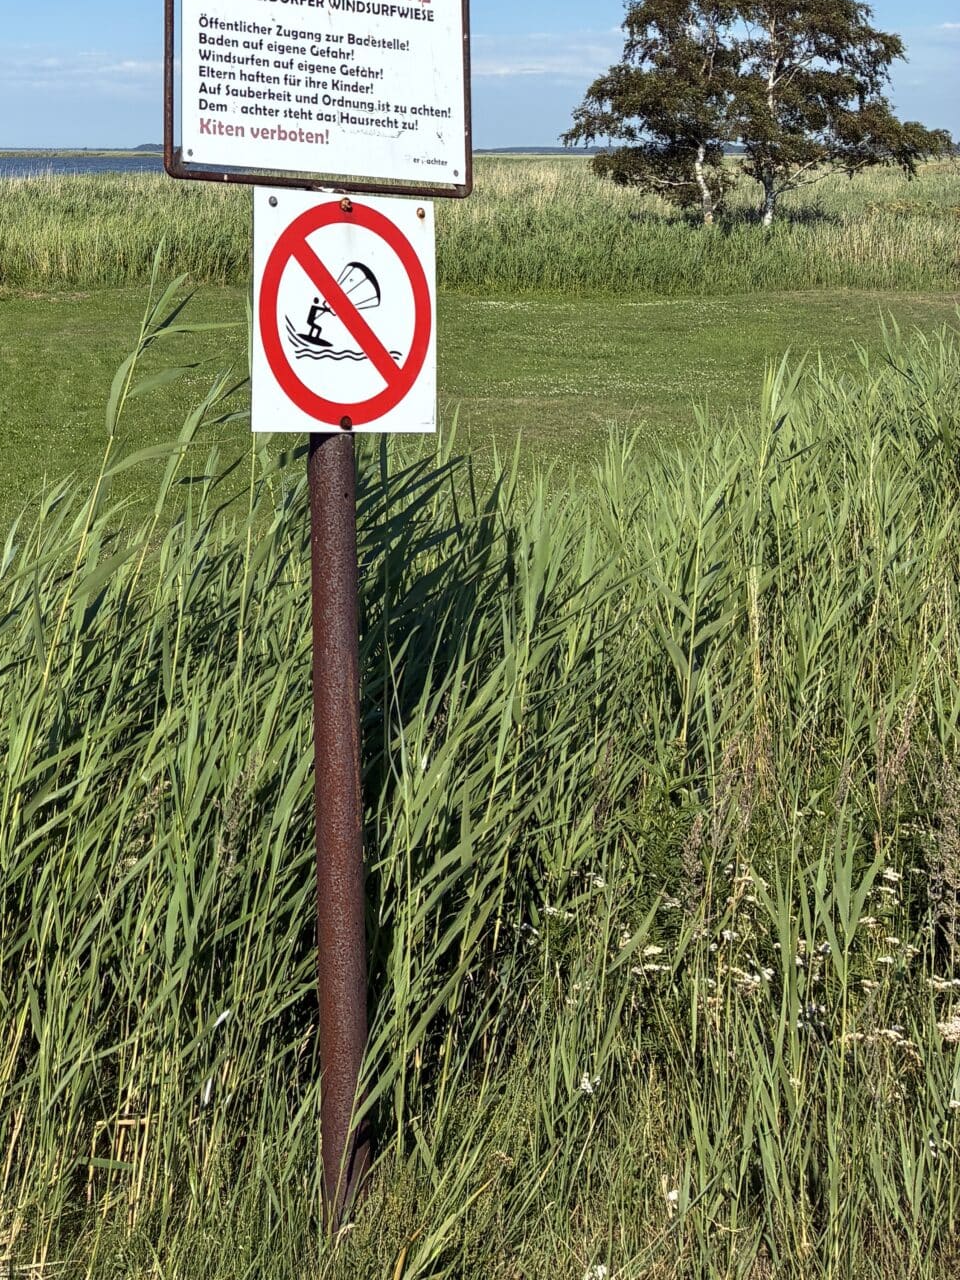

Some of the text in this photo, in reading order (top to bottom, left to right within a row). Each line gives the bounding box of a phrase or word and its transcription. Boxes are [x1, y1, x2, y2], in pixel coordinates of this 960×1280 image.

[199, 13, 409, 51] Öffentlicher Zugang zur Badestelle!
[199, 32, 354, 60] Baden auf eigene Gefahr!
[199, 49, 383, 80] Windsurfen auf eigene Gefahr!
[199, 65, 374, 94] Eltern haften für ihre Kinder!
[199, 81, 451, 118] Auf Sauberkeit und Ordnung ist zu achten!
[199, 98, 227, 112] Dem
[283, 107, 312, 120] steht
[340, 112, 399, 129] Hausrecht
[401, 119, 418, 131] zu!
[200, 118, 329, 144] Kiten verboten!
